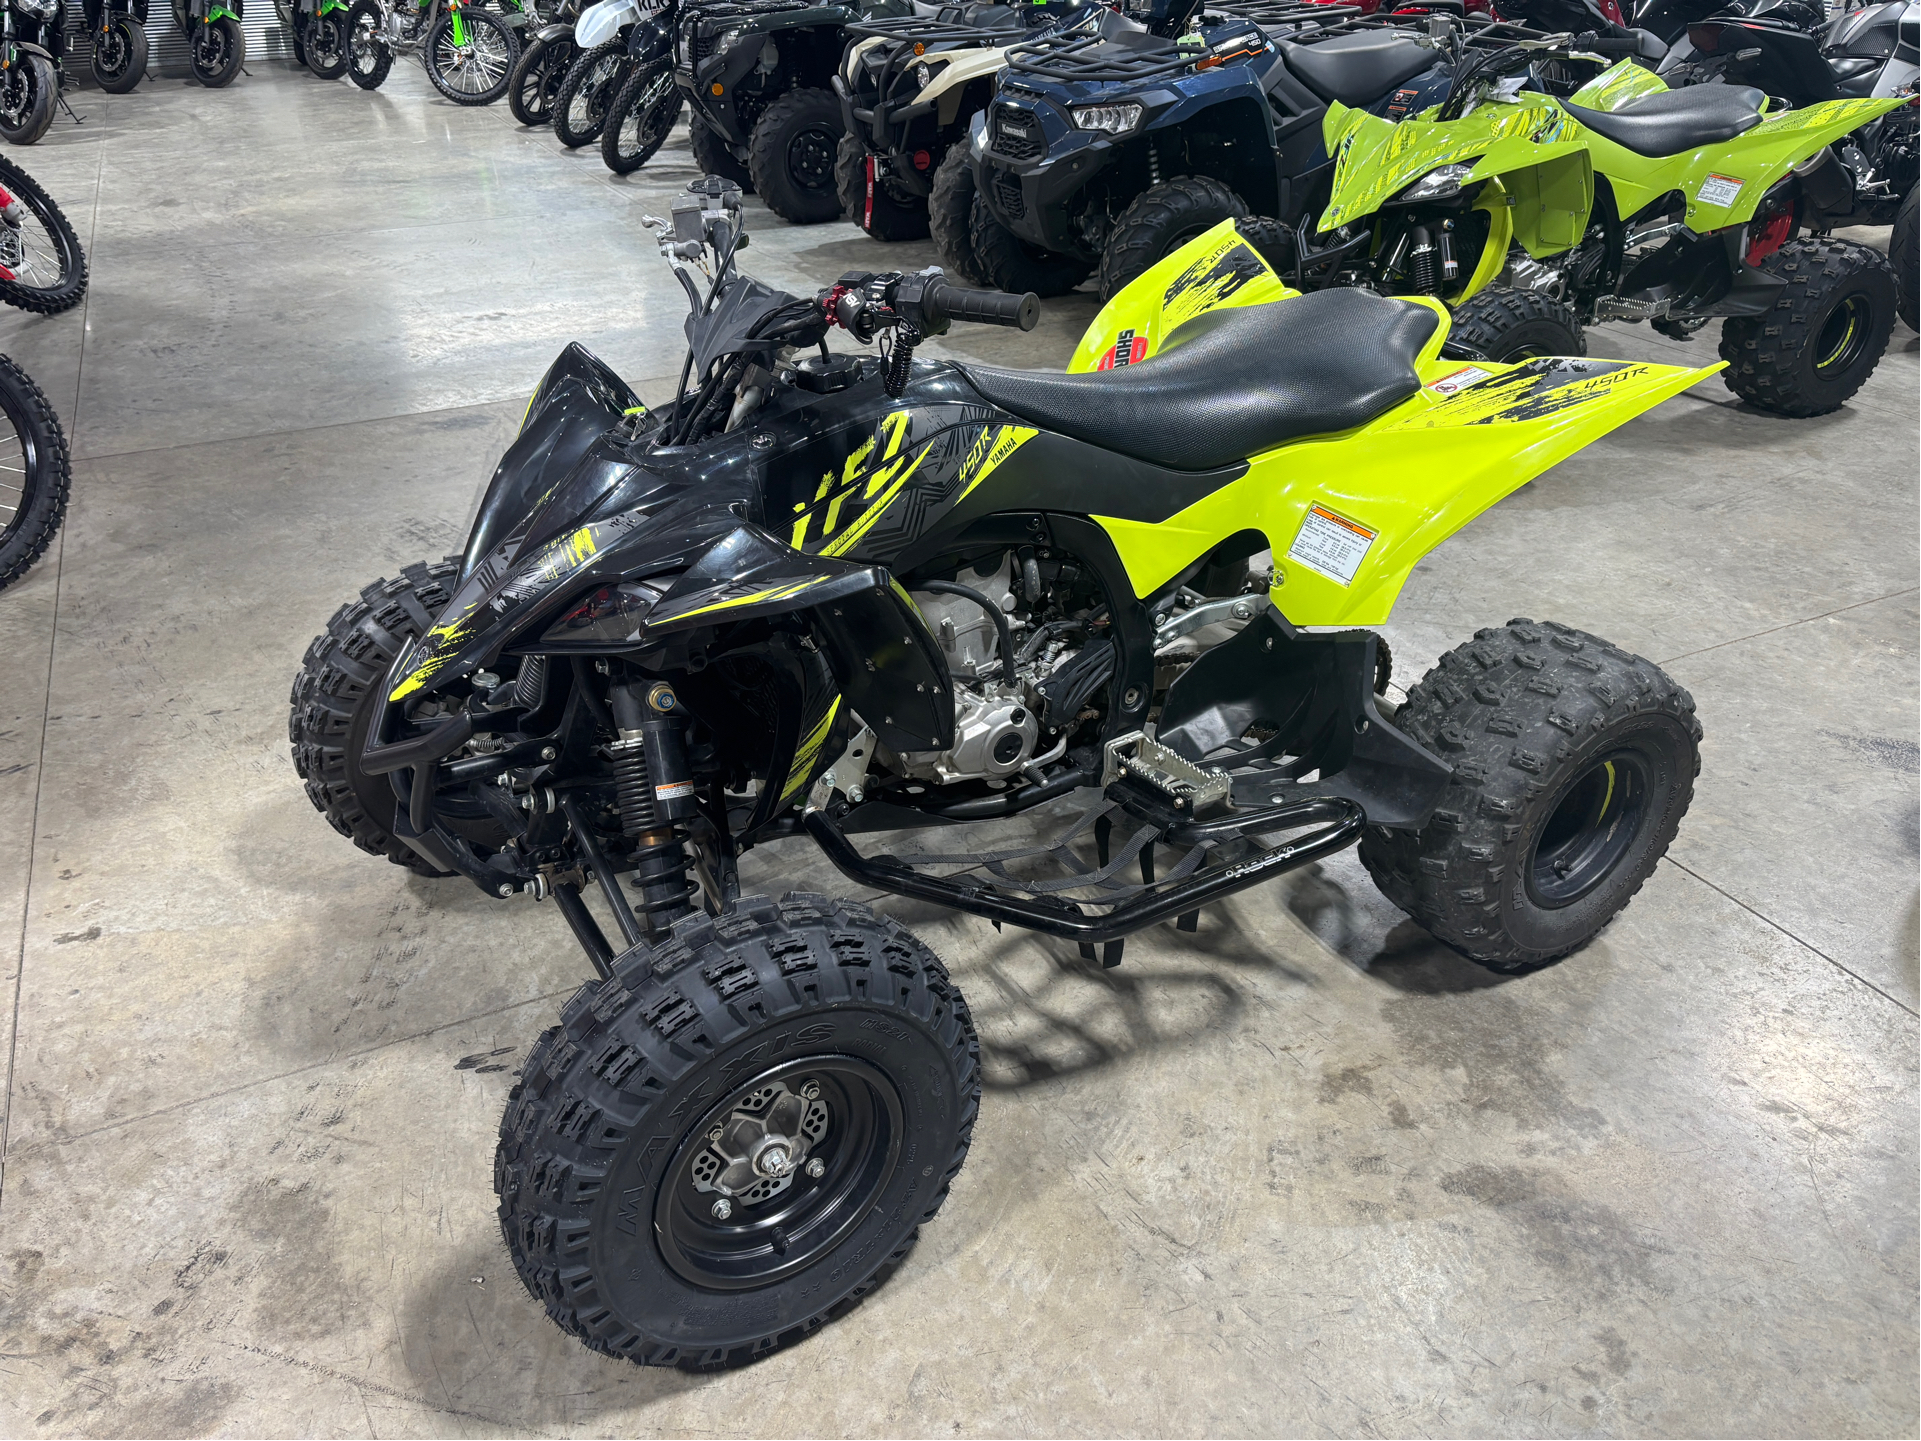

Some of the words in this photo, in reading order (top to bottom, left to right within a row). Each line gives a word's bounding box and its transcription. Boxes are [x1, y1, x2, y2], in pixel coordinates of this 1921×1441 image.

[1002, 123, 1027, 138] Kawasaki
[1584, 366, 1649, 391] 450R
[959, 425, 992, 483] 450R
[990, 437, 1018, 466] YAMAHA
[1335, 518, 1353, 529] WARNING
[616, 1022, 836, 1236] MAXXIS
